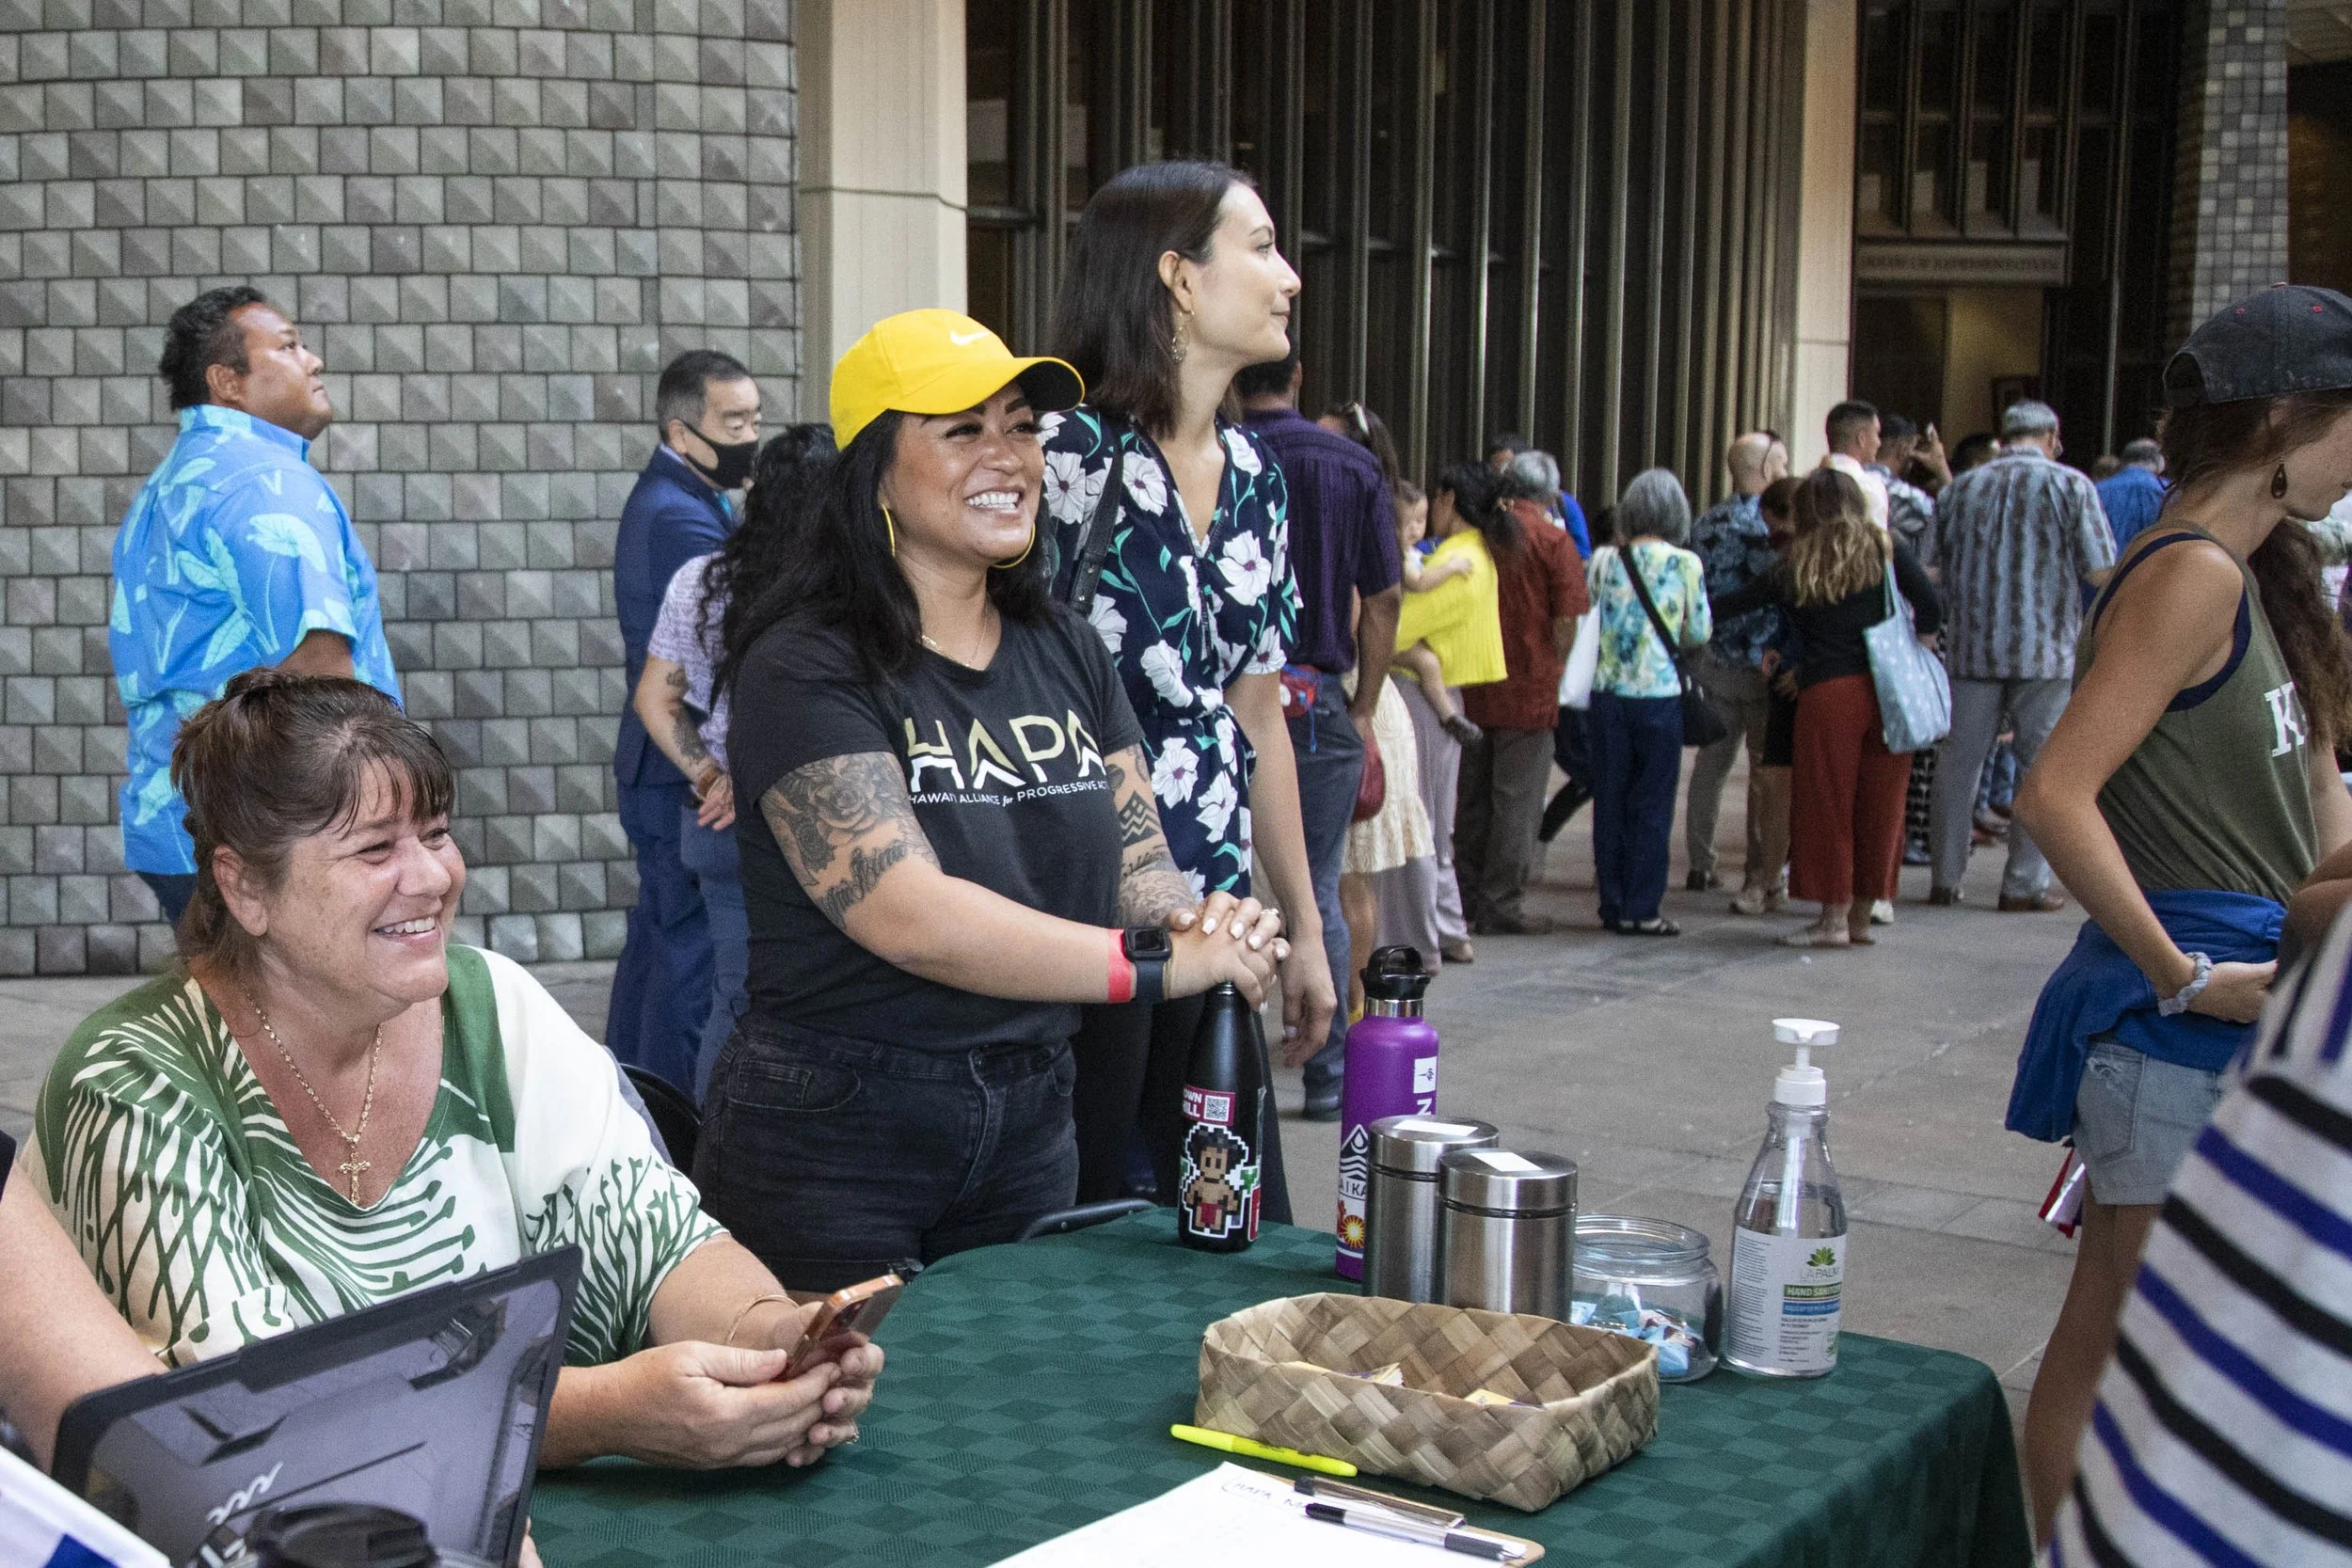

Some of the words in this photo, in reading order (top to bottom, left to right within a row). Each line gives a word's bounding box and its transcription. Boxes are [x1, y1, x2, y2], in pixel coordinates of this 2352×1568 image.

[904, 709, 1106, 792] HAPA
[1002, 796, 1013, 807] for
[1017, 781, 1096, 801] PROGRESSIVE
[1788, 1287, 1812, 1297] HAND
